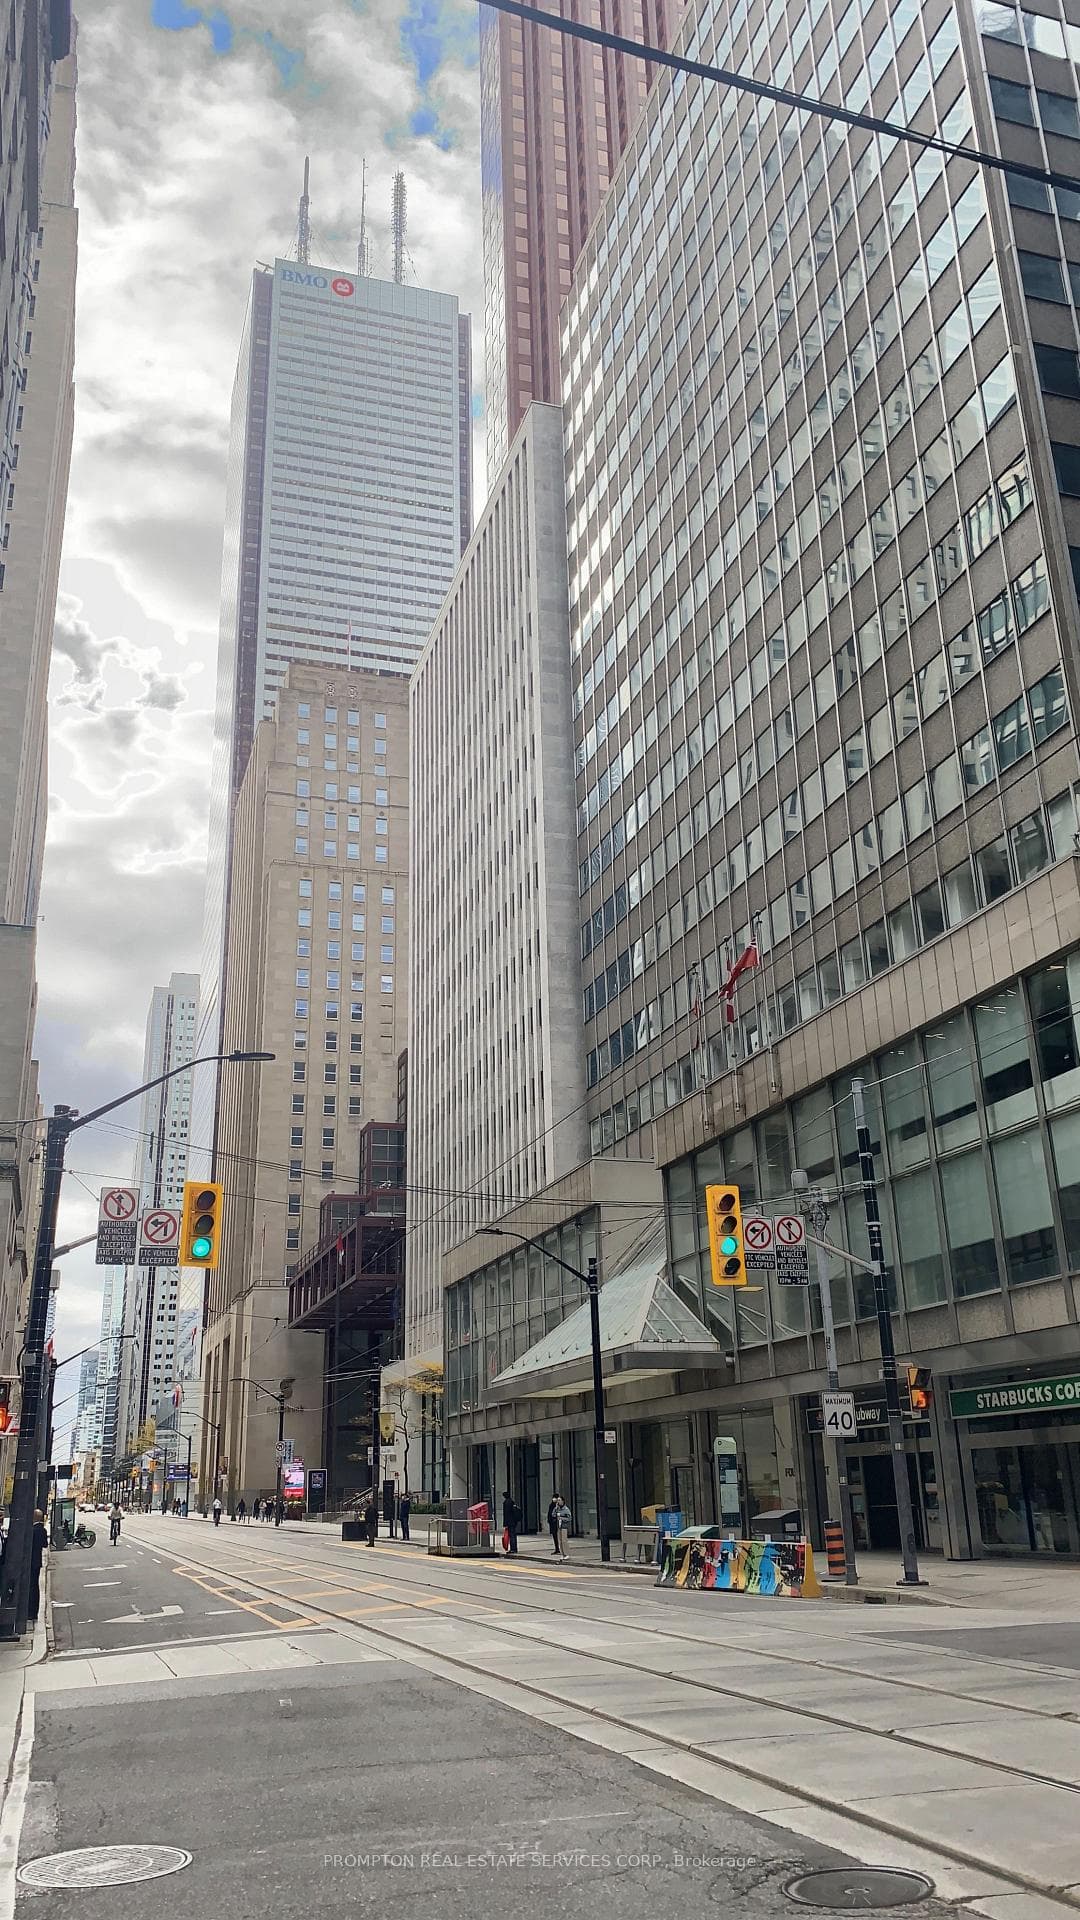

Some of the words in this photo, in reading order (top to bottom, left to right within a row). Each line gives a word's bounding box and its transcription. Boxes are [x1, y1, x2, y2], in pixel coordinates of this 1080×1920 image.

[280, 268, 328, 289] BMO
[976, 1385, 1053, 1409] STARBUCKS
[827, 1411, 853, 1430] 40
[855, 1407, 881, 1421] ubway
